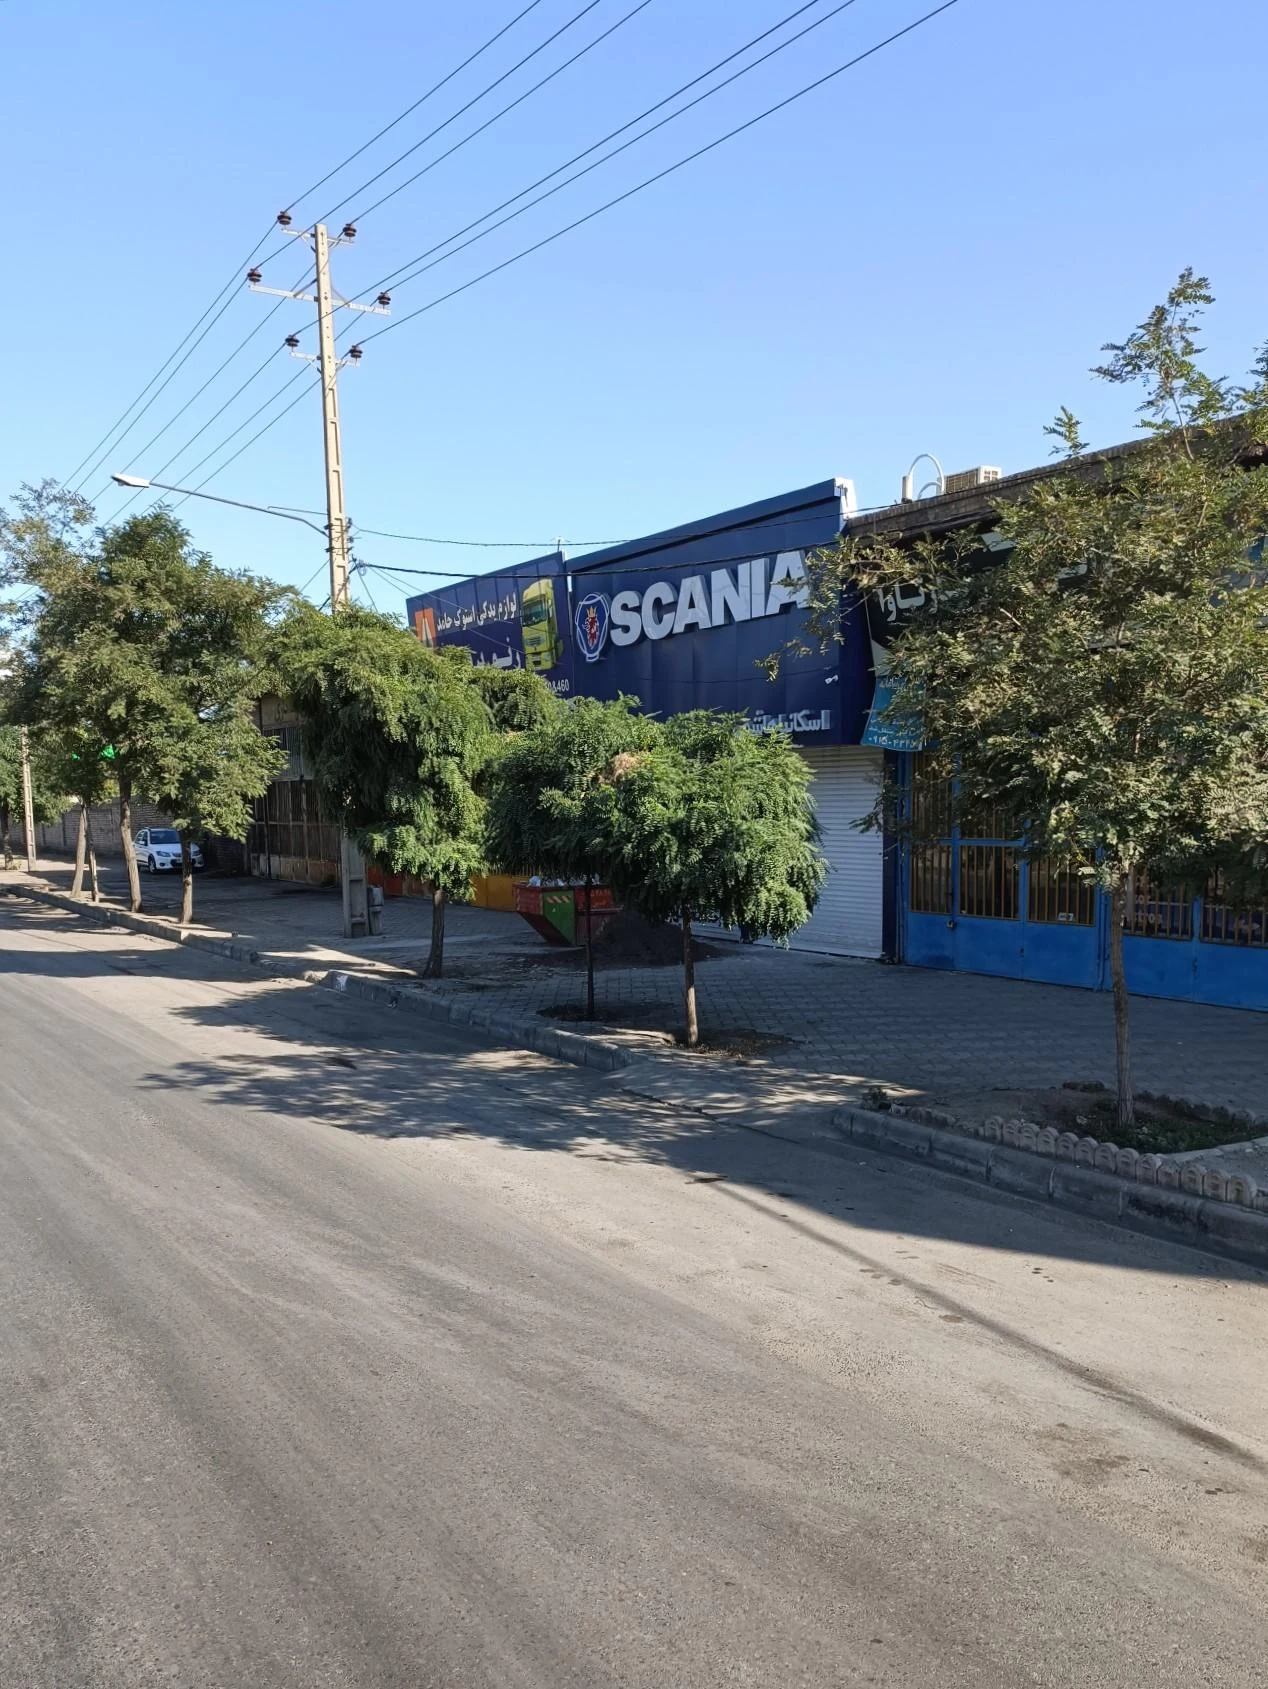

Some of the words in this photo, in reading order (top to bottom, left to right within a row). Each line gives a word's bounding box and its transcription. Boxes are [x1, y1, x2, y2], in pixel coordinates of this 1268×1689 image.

[498, 592, 518, 621] لوازم
[610, 550, 811, 647] SCANIA
[477, 600, 496, 626] یدکی
[778, 709, 832, 733] اسکانیا
